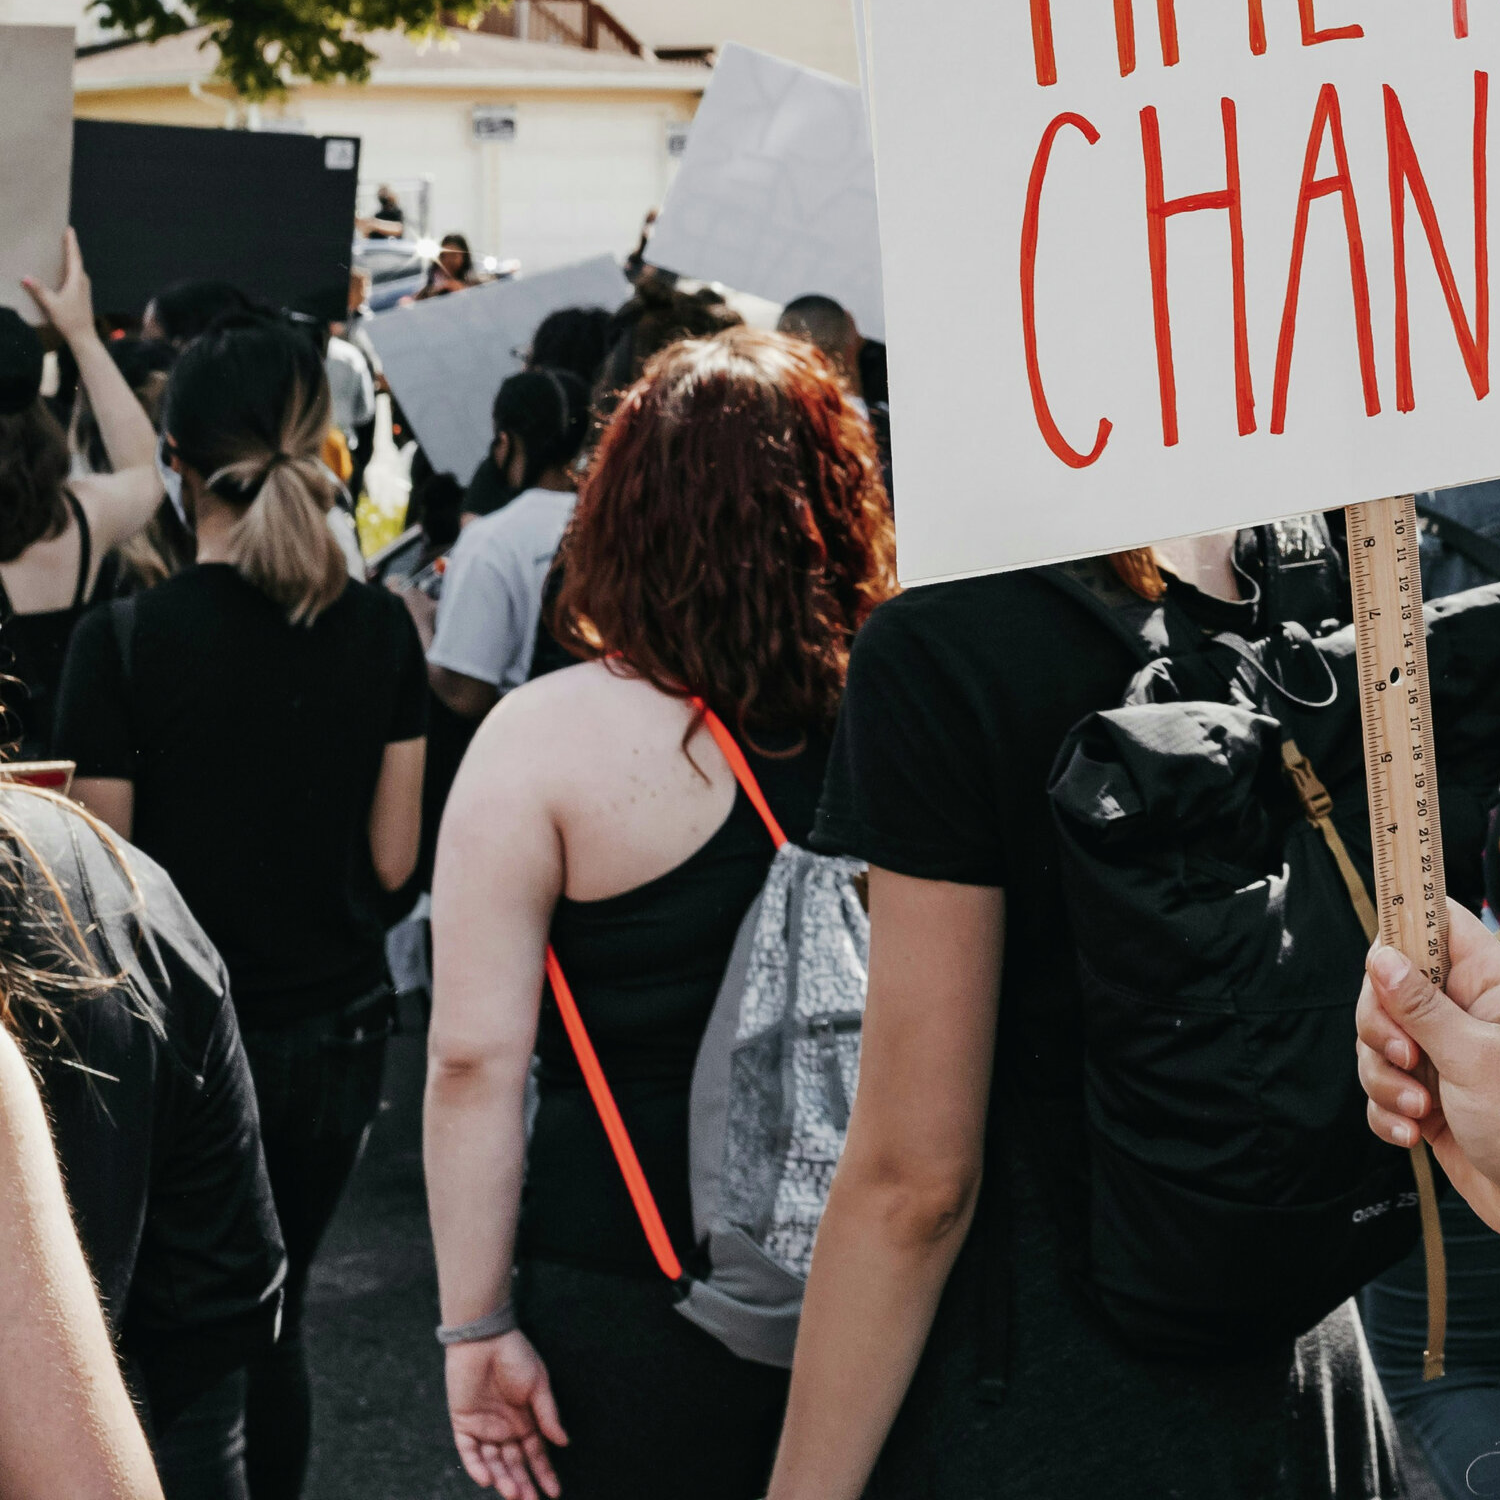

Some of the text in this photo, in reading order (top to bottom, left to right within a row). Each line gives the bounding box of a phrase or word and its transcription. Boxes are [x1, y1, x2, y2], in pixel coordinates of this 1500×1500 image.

[1363, 538, 1376, 548] 8
[1369, 611, 1381, 620] 7
[1394, 519, 1441, 984] 10 11 12 13 14 15 16 17 18 19 20 21 22 23 24 25 26
[1380, 753, 1393, 763] 5
[1387, 824, 1399, 834] 4
[1392, 896, 1404, 906] 3
